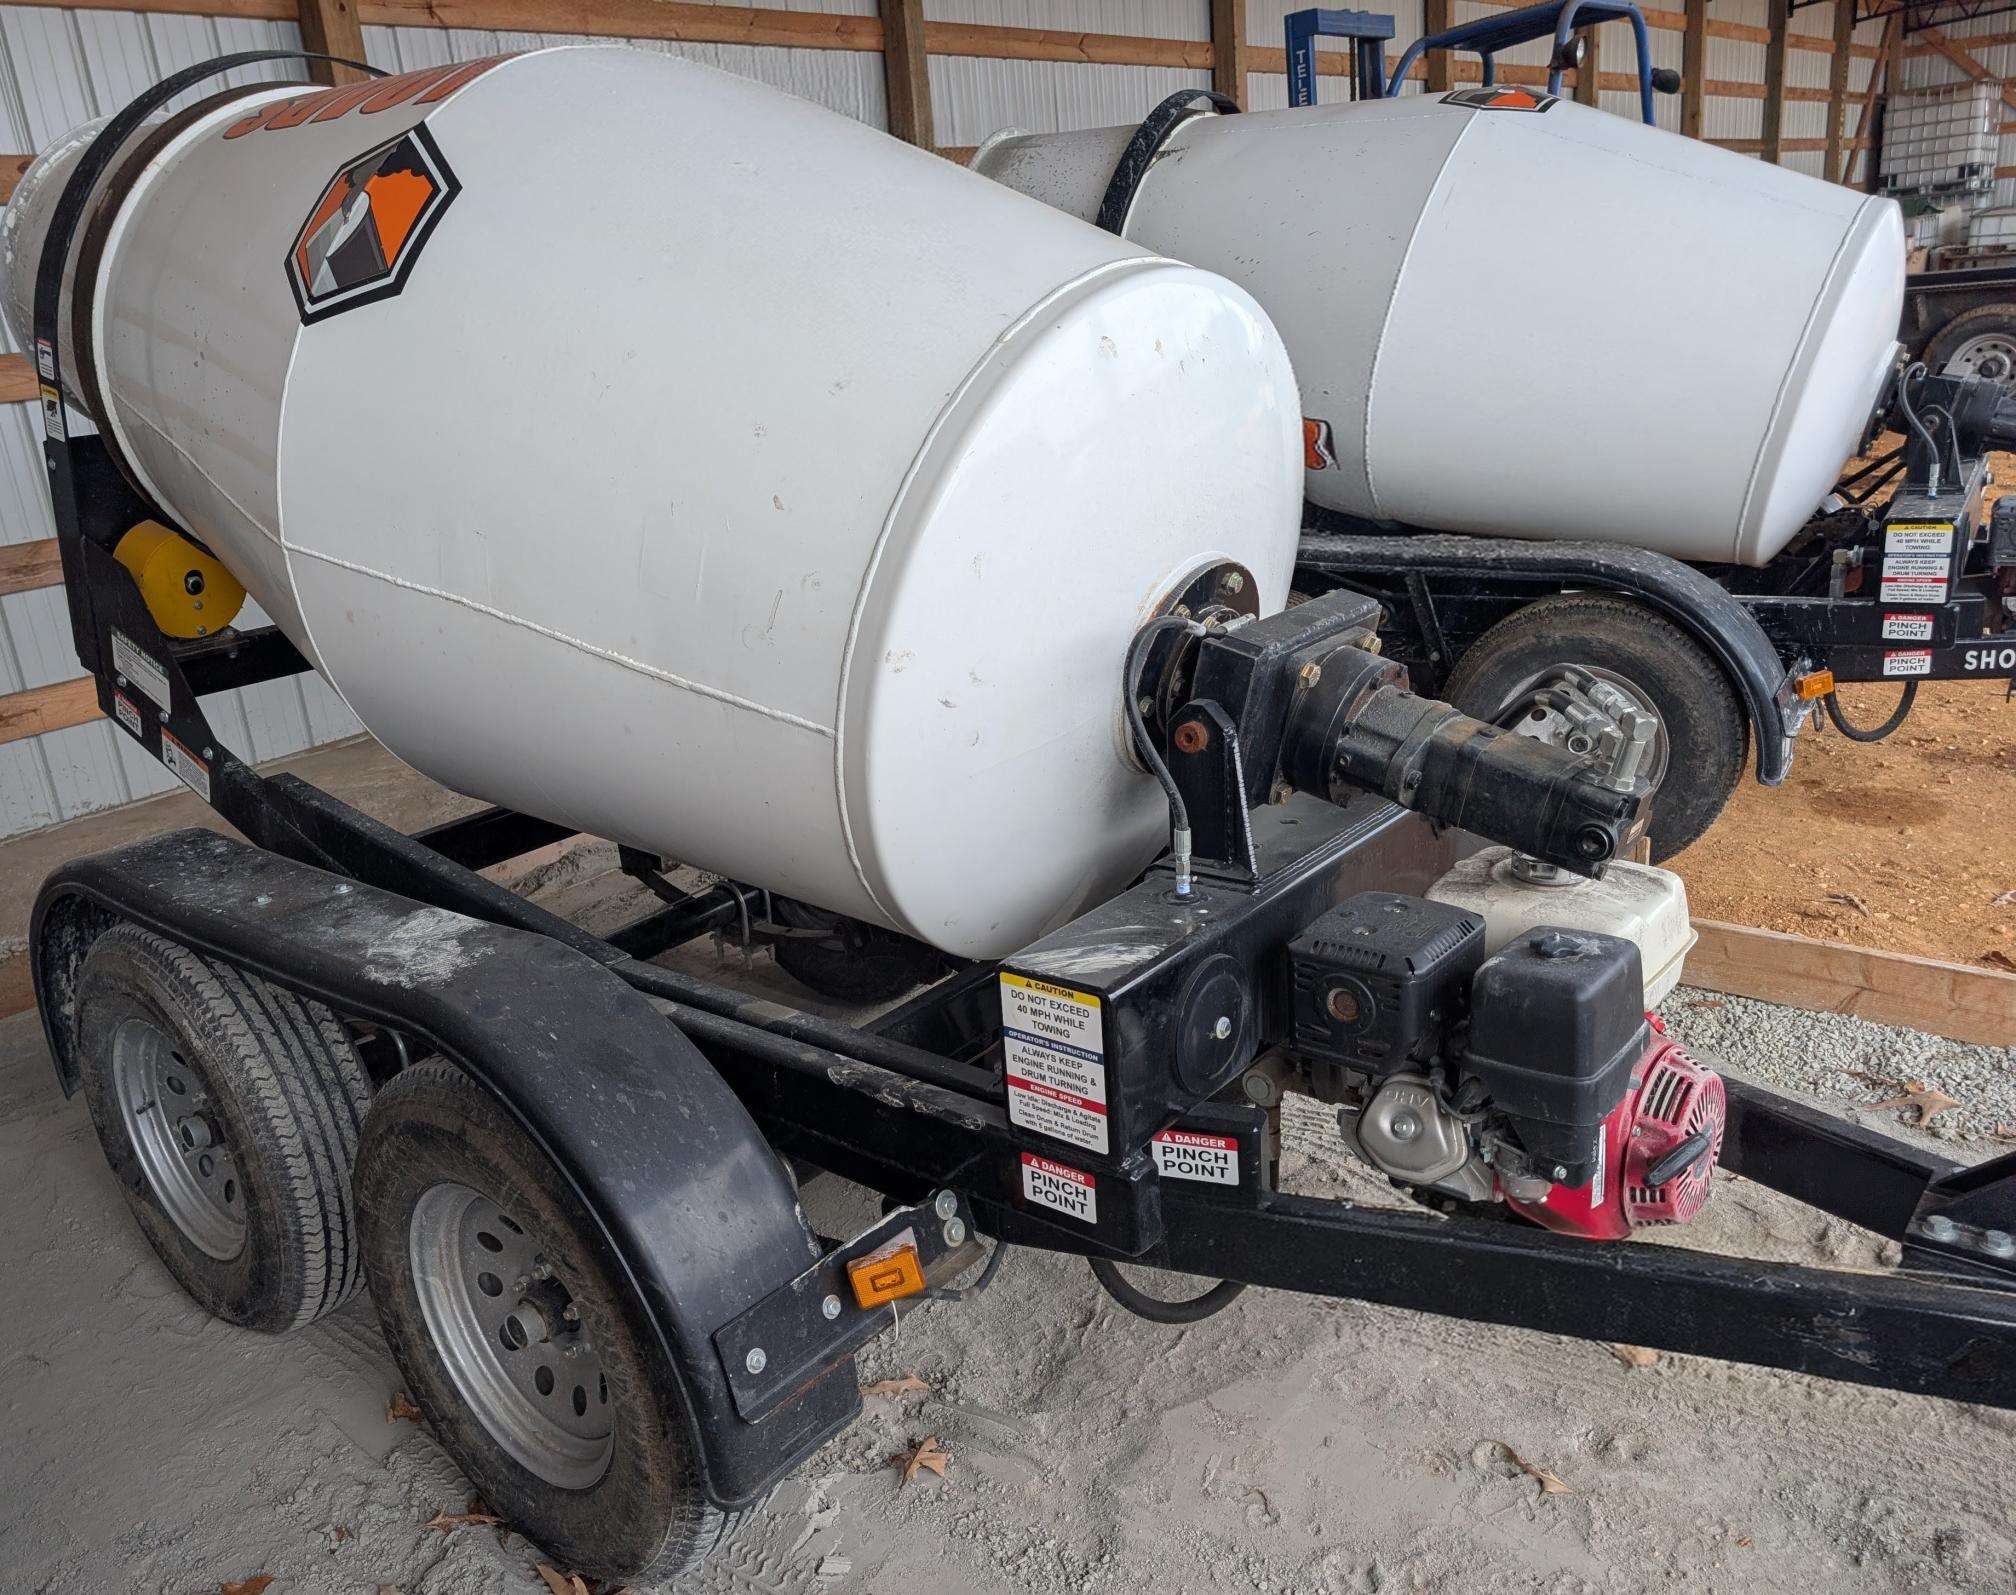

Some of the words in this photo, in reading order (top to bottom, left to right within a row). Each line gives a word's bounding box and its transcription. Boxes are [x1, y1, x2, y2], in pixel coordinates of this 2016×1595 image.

[1888, 621, 1927, 630] PINCH
[1888, 629, 1927, 637] POINT
[1889, 657, 1926, 666] PINCH
[1889, 664, 1927, 673] POINT
[1964, 648, 2016, 670] SHO
[1034, 982, 1075, 999] CAUTION
[1010, 989, 1025, 1001] DO
[1027, 994, 1047, 1006] NOT
[1049, 1000, 1090, 1019] EXCEED
[1017, 1004, 1028, 1014] 40
[1030, 1007, 1052, 1020] MPH
[1053, 1013, 1086, 1031] WHILE
[1031, 1020, 1071, 1039] TOWING
[1008, 1030, 1050, 1047] OPERATOR'S
[1051, 1042, 1098, 1062] INSTRUCTION
[1021, 1046, 1057, 1063] ALWAYS
[1058, 1056, 1083, 1070] KEEP
[1012, 1054, 1045, 1070] ENGINE
[1047, 1064, 1088, 1084] RUNNING
[1090, 1077, 1097, 1087] &
[1021, 1068, 1047, 1082] DRUM
[1048, 1076, 1089, 1095] TURNING
[1013, 1090, 1026, 1099] Low
[1041, 1099, 1072, 1114] Discharge
[1030, 1084, 1058, 1098] ENGINE
[1058, 1093, 1083, 1106] SPEED
[1018, 1109, 1035, 1119] Clean
[1036, 1113, 1053, 1125] Drum
[1060, 1122, 1081, 1135] Return
[1082, 1130, 1099, 1141] Drum
[1072, 1116, 1097, 1131] Loading
[1174, 1134, 1226, 1148] DANGER
[1161, 1145, 1228, 1165] PINCH
[1041, 1161, 1086, 1184] DANGER
[1163, 1159, 1229, 1179] POINT
[1030, 1170, 1087, 1201] PINCH
[1032, 1184, 1088, 1214] POINT
